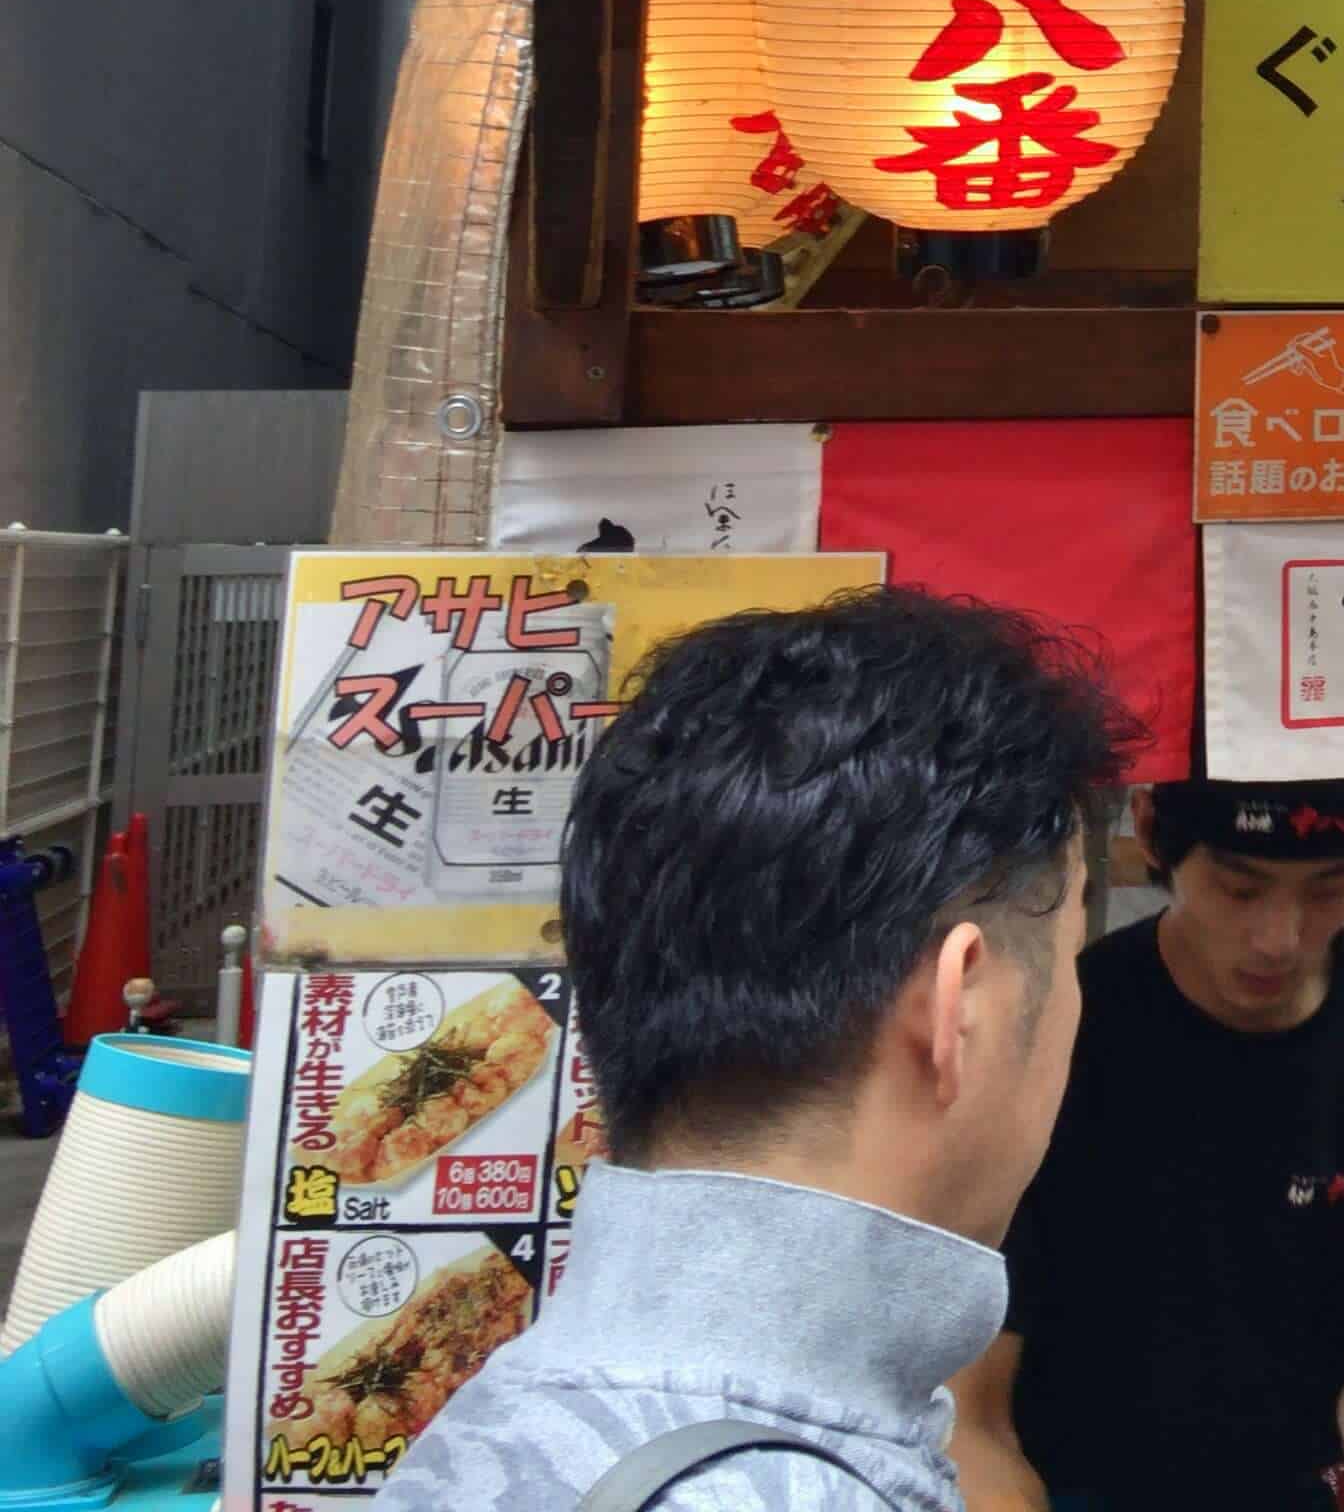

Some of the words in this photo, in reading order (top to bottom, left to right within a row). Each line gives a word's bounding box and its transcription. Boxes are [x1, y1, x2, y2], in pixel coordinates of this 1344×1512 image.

[340, 574, 582, 652] アサヒ
[348, 783, 423, 848] 生
[491, 786, 533, 816] 生
[536, 973, 562, 1000] 2
[291, 973, 355, 1152] 素材が生きる
[285, 1165, 341, 1225] 塩
[343, 1196, 391, 1222] Salt
[510, 1234, 535, 1261] 4
[269, 1237, 330, 1421] 店長おすすめ
